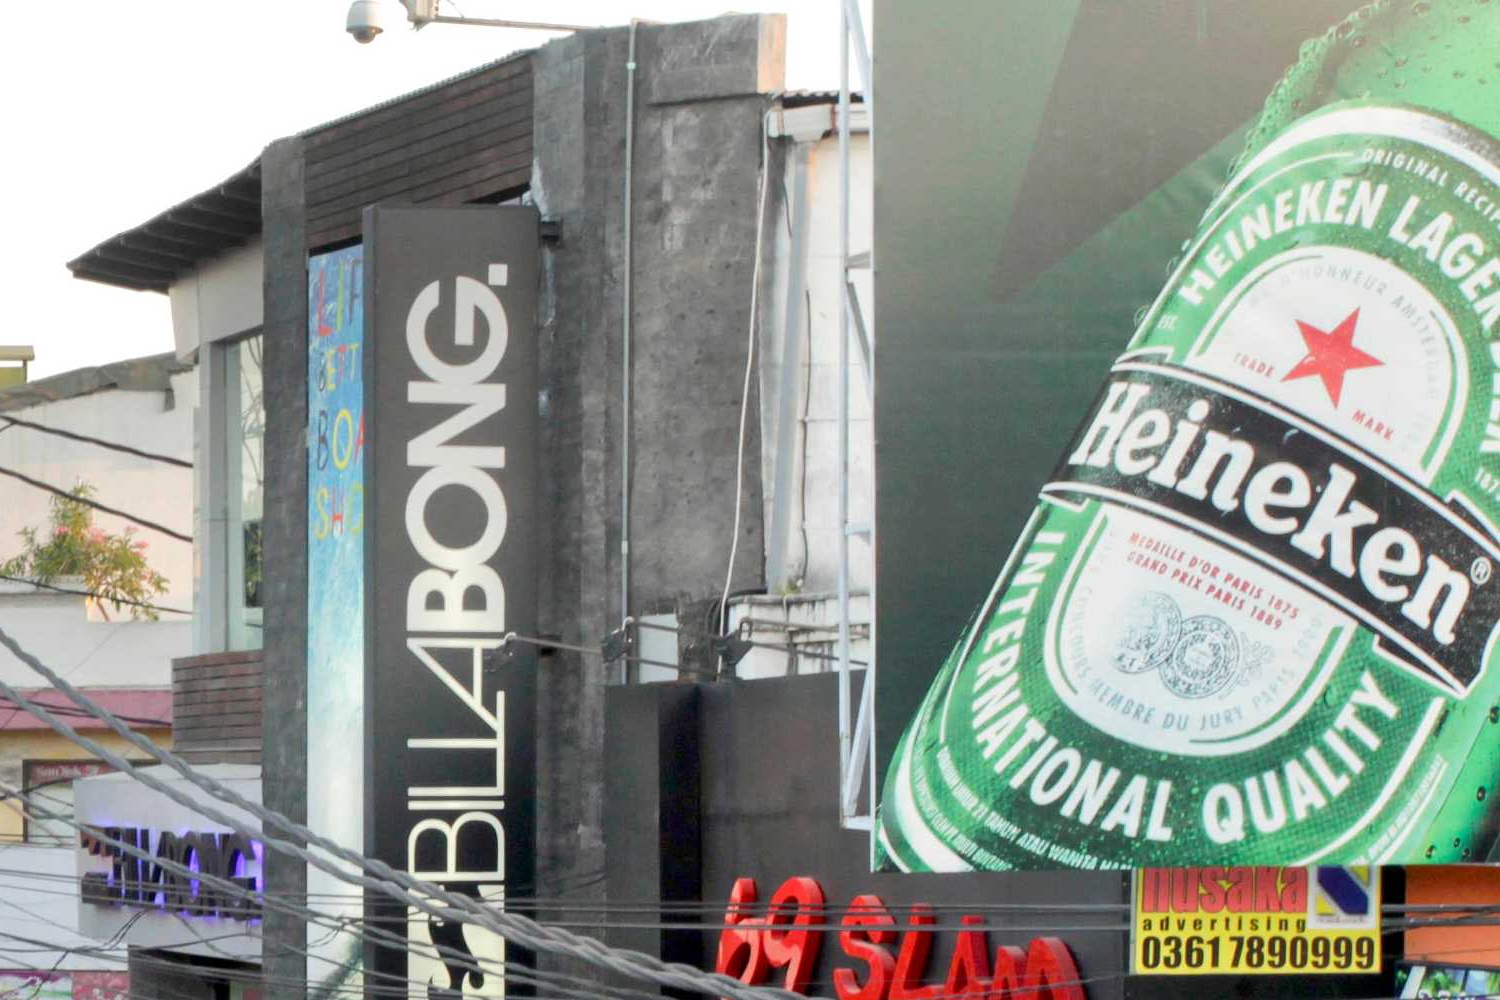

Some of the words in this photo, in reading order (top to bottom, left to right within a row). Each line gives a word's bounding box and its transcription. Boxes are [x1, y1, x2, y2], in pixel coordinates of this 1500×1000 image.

[1361, 148, 1450, 187] ORIGINAL
[1178, 178, 1388, 305] HEINEKEN
[1233, 351, 1278, 379] TRADE
[1351, 408, 1396, 441] MARK
[1068, 382, 1471, 646] Heineken
[1171, 568, 1203, 591] PRIX
[1205, 583, 1246, 611] PARIS
[1188, 555, 1220, 578] D'OR
[1224, 570, 1263, 599] PARIS
[1267, 594, 1300, 620] 1875
[971, 531, 1173, 842] INTERNATIONAL
[1162, 711, 1189, 732] DU
[1199, 706, 1244, 732] JURY
[1203, 670, 1398, 845] QUALITY
[1143, 915, 1307, 933] advertising
[1142, 936, 1221, 970] 0361
[1228, 936, 1376, 970] 7890999
